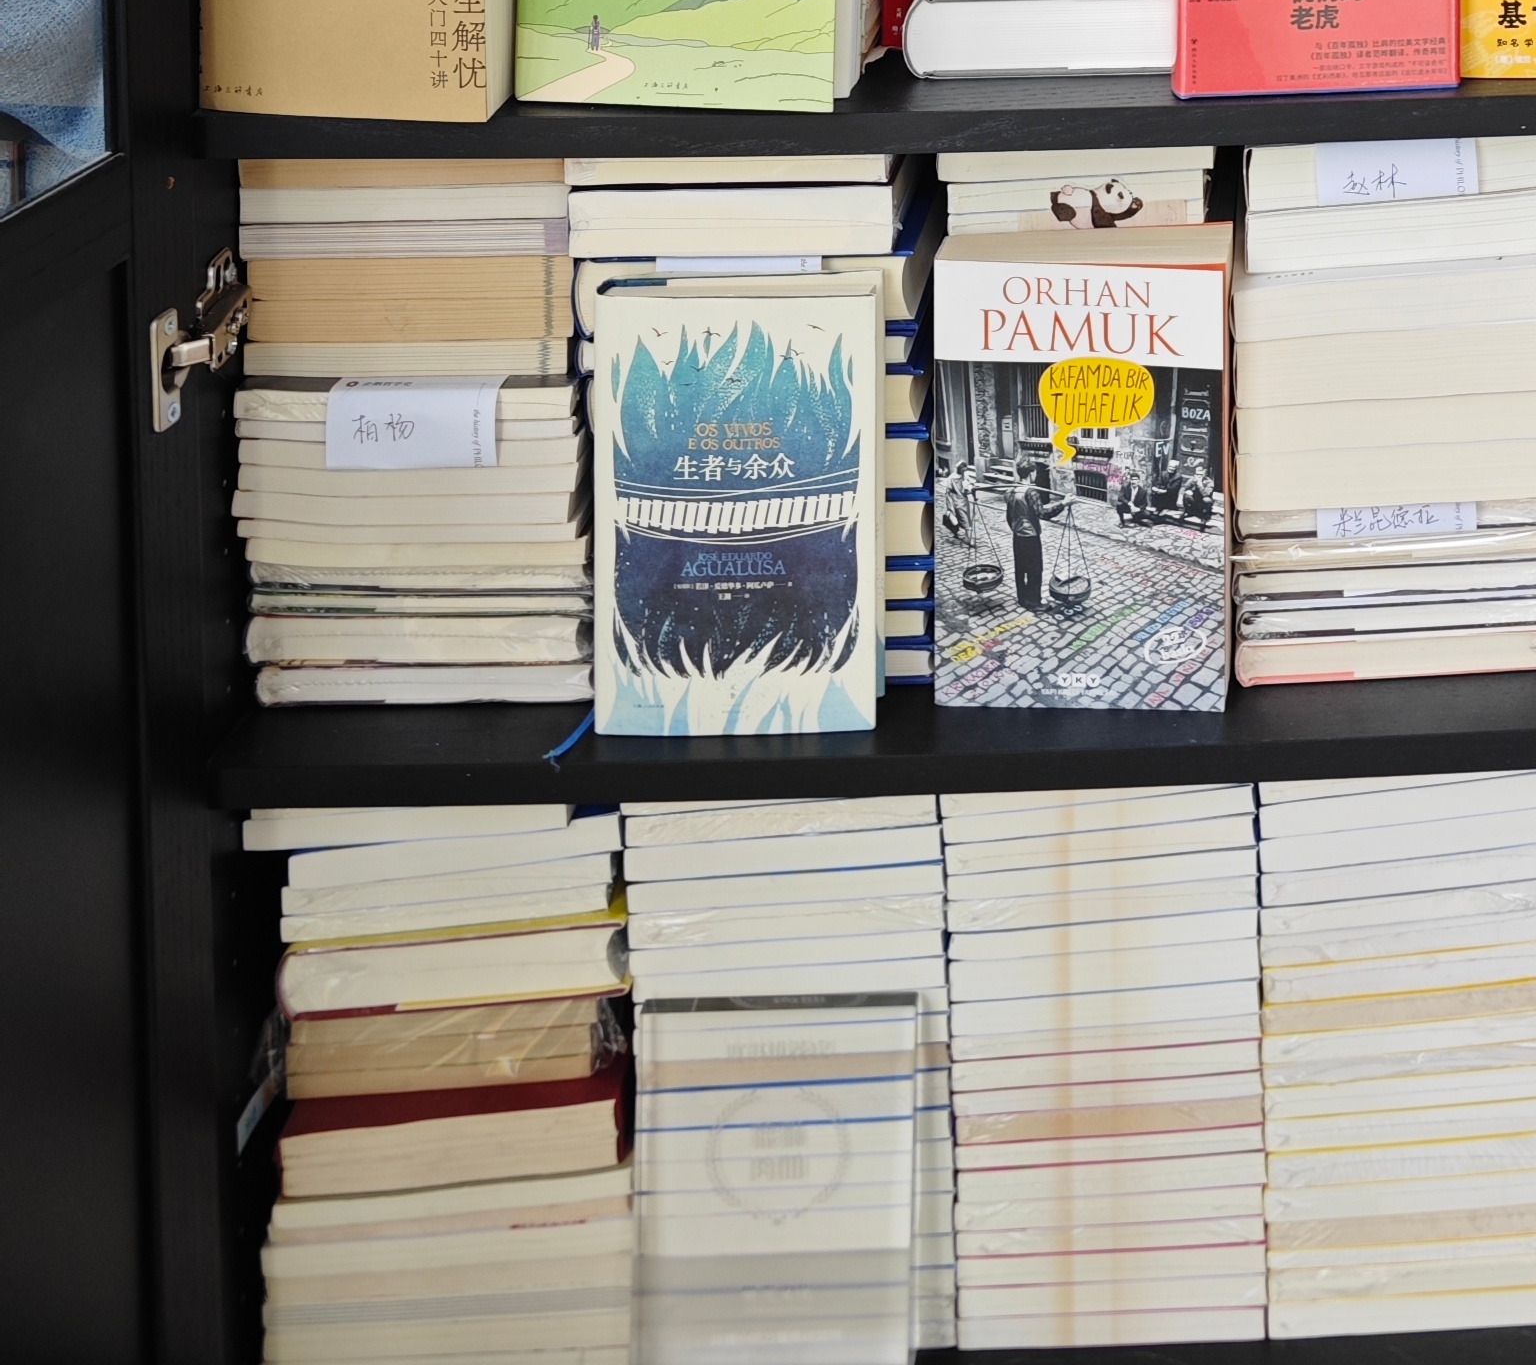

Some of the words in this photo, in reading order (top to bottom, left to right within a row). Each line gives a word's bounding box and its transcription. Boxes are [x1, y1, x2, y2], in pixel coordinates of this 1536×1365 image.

[1289, 4, 1340, 31] 老虎
[1342, 163, 1407, 195] 赵林
[1002, 277, 1152, 310] ORHAN
[980, 309, 1184, 357] PAMUK
[1050, 391, 1145, 426] TUHAFLIK
[1181, 407, 1211, 422] BOZA
[351, 413, 416, 446] 柏杨
[695, 422, 719, 437] OS
[723, 421, 772, 437] VIVOS
[673, 452, 796, 482] 生者与余众
[680, 559, 787, 577] AGUALUSA
[697, 550, 721, 562] JOSÉ
[722, 550, 772, 562] EDUARDO
